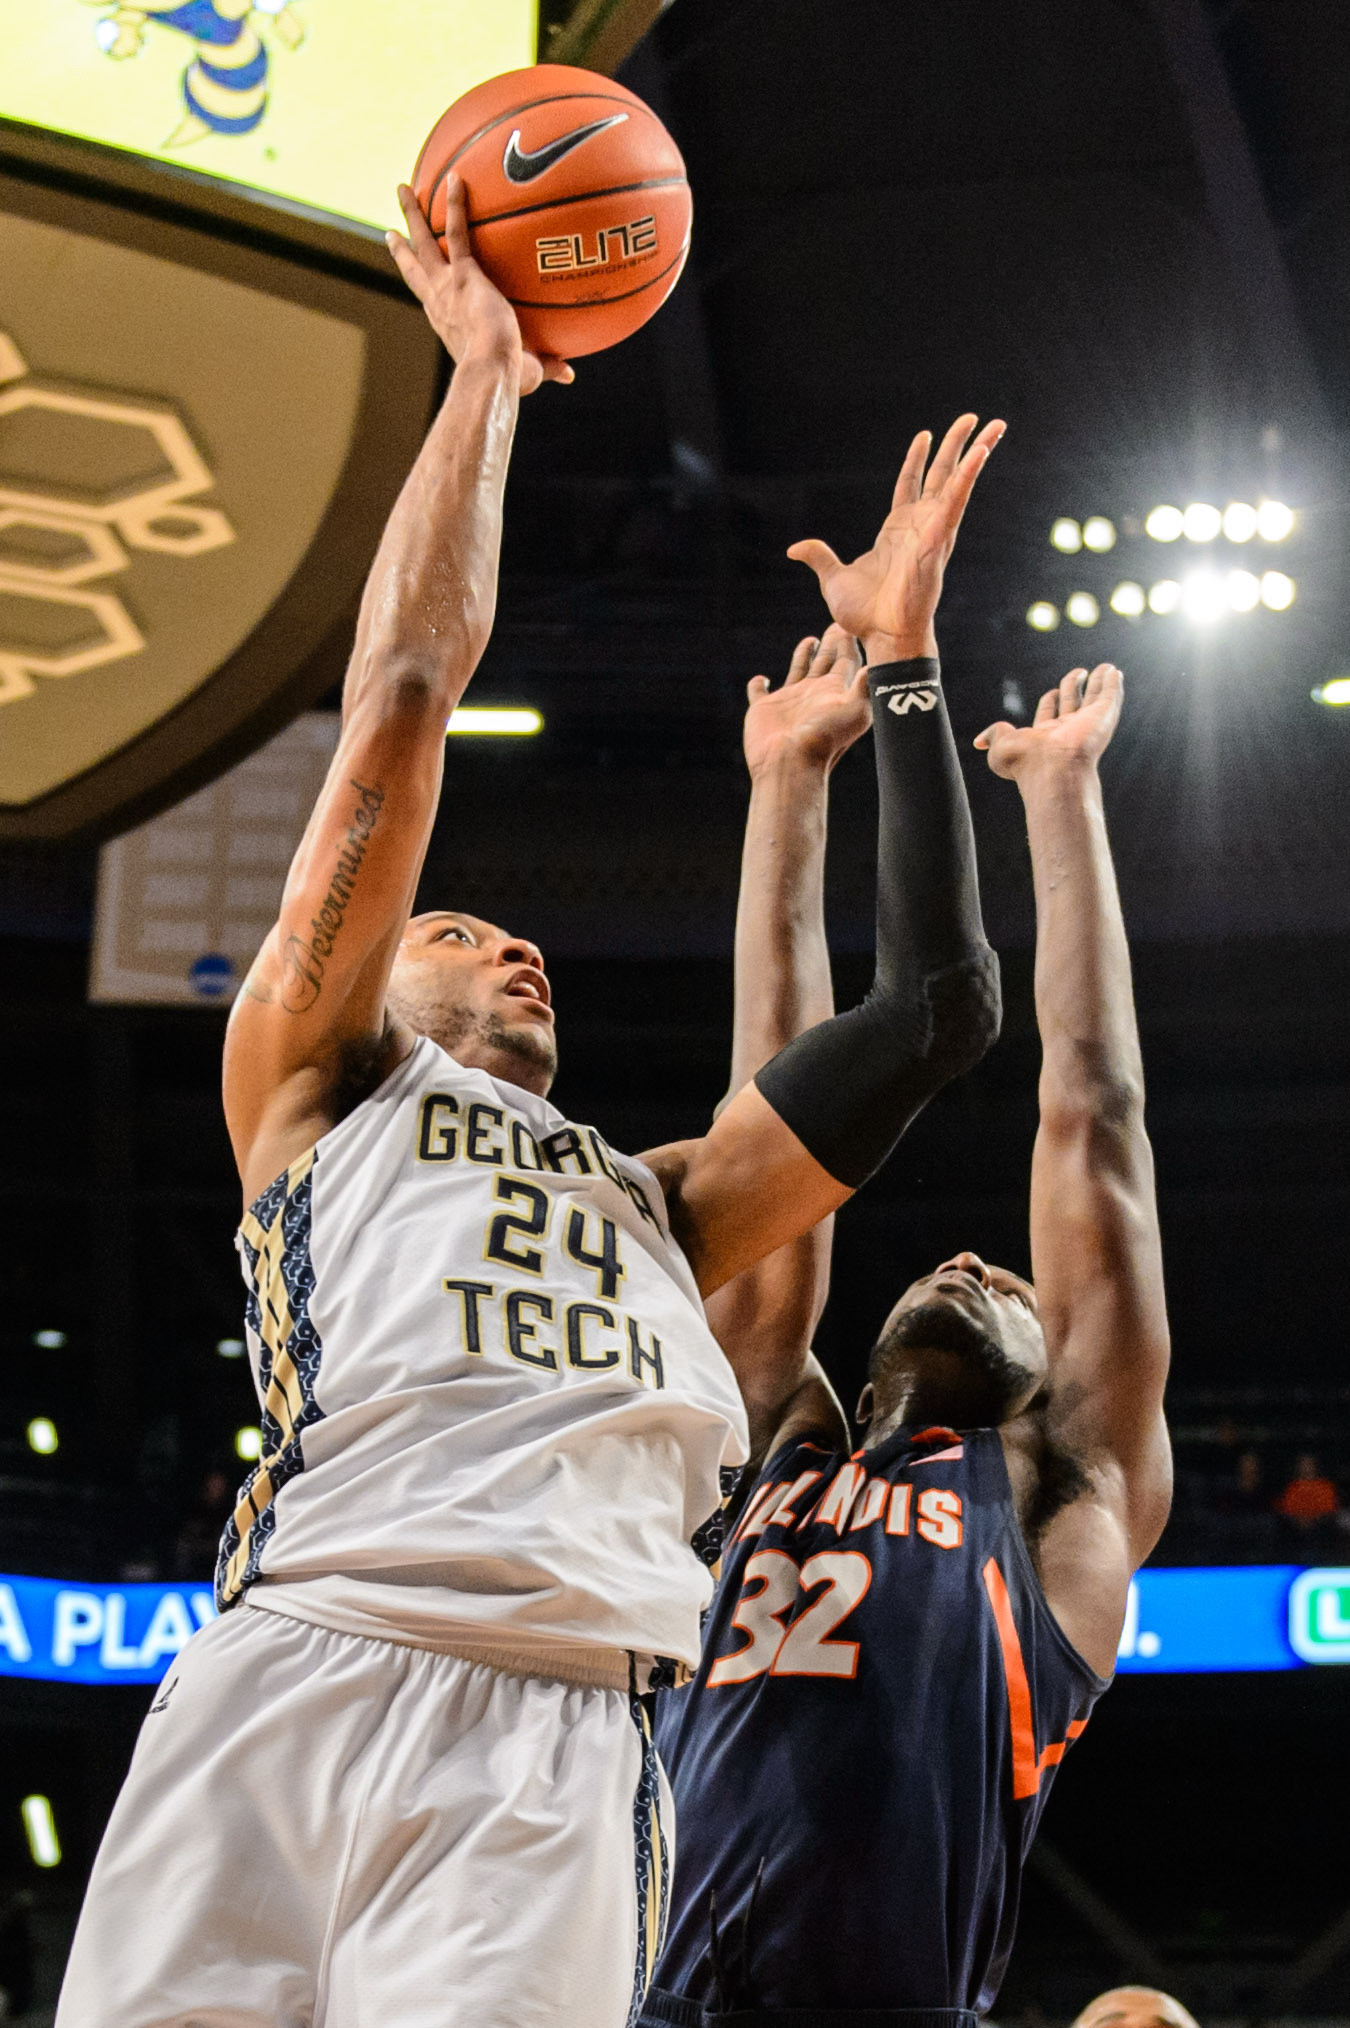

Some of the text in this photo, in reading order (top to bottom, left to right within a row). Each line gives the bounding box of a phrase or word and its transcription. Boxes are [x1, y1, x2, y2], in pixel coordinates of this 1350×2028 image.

[535, 214, 657, 273] ELITE
[281, 778, 386, 1015] Determined
[415, 1091, 667, 1246] GEORGA
[482, 1171, 628, 1304] 24
[442, 1278, 665, 1391] TECH
[705, 1548, 873, 1689] 32
